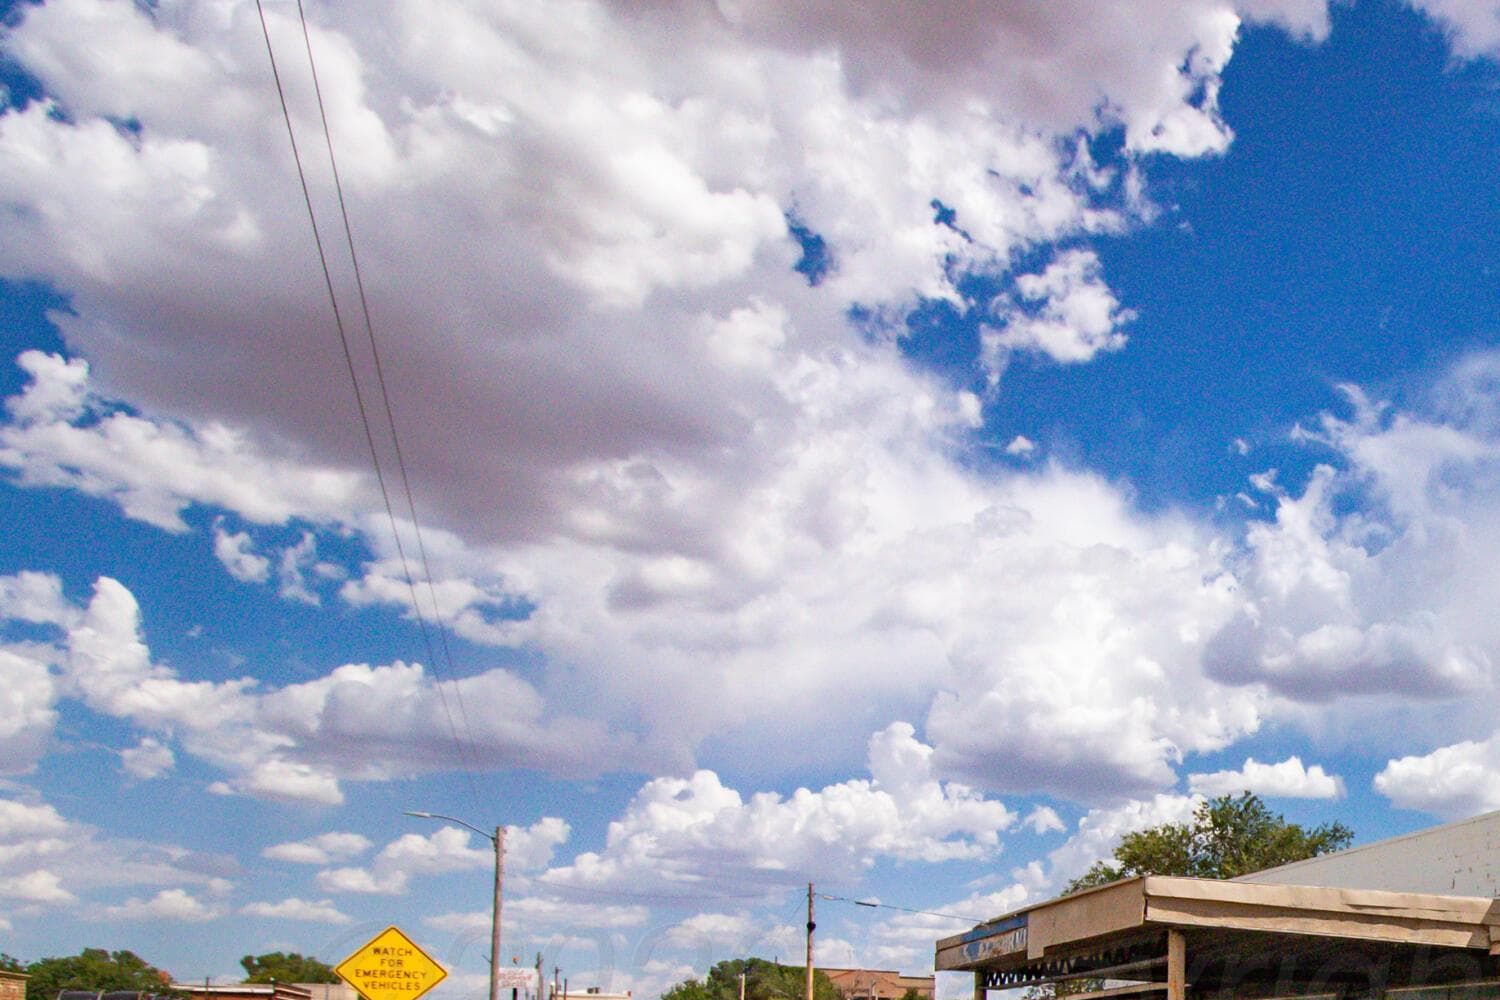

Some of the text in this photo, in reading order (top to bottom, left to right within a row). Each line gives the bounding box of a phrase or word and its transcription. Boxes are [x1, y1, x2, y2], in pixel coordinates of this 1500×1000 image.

[372, 947, 413, 956] WATCH
[380, 958, 403, 968] FOR
[354, 968, 427, 979] EMERGENCY
[362, 980, 421, 991] VEHICLES
